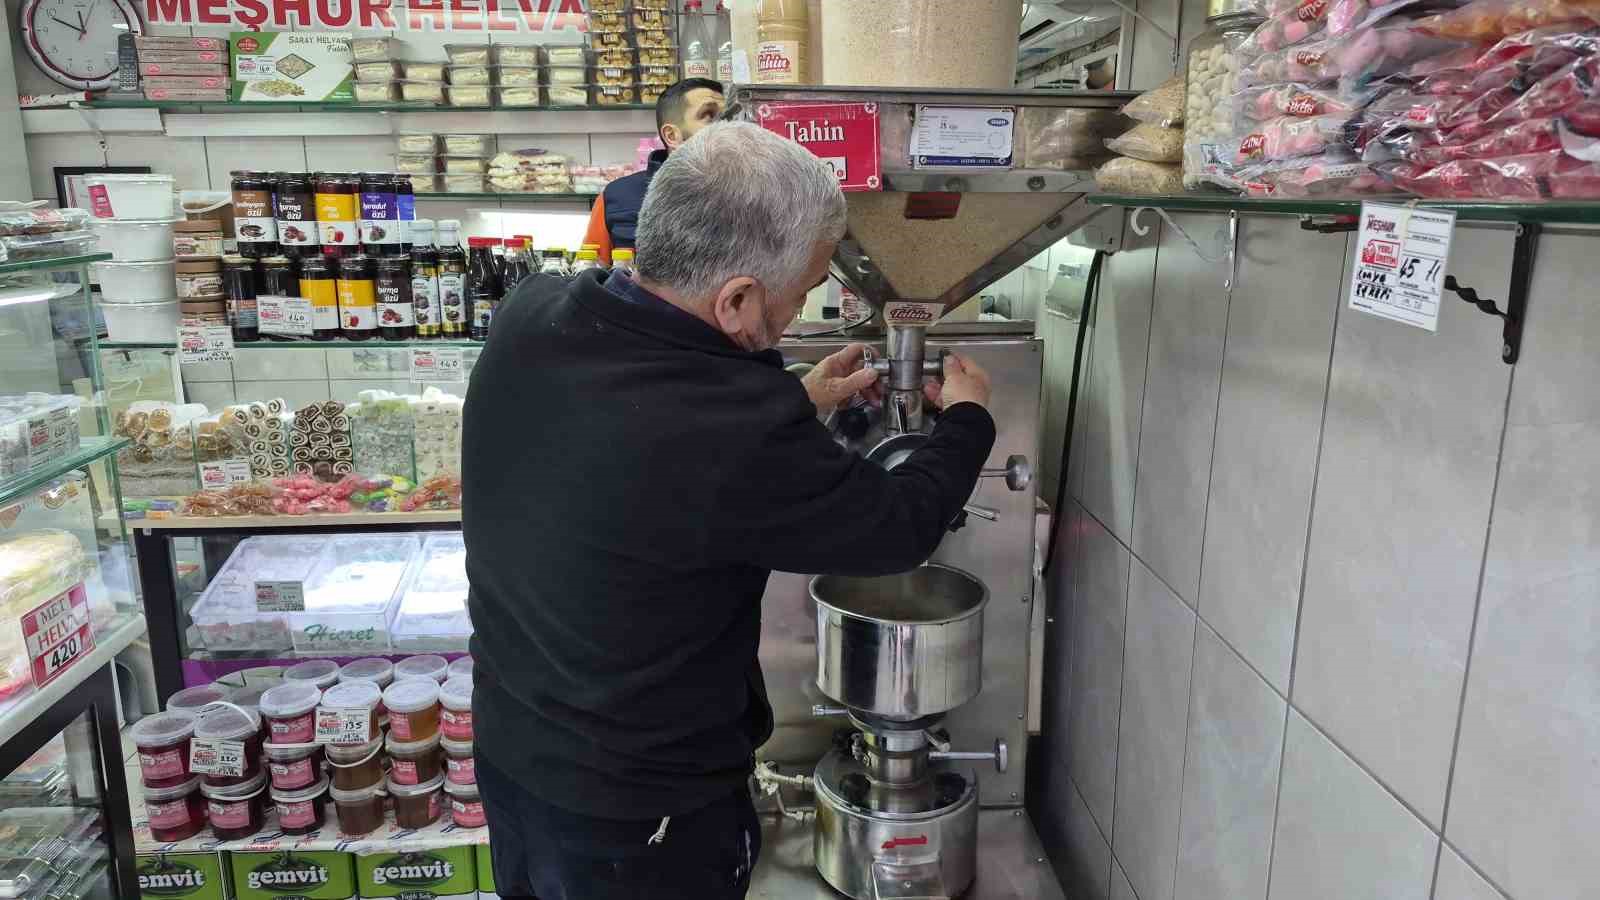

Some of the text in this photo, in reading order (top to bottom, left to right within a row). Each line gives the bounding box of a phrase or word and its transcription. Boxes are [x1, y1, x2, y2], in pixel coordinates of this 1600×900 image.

[408, 0, 587, 31] HELVA
[784, 119, 846, 143] Tahin
[371, 209, 387, 218] özü
[1399, 258, 1421, 279] 45
[51, 638, 78, 669] 420
[345, 720, 363, 730] 135
[138, 869, 205, 889] emvit
[247, 864, 330, 889] gemvit
[372, 860, 455, 885] gemvit
